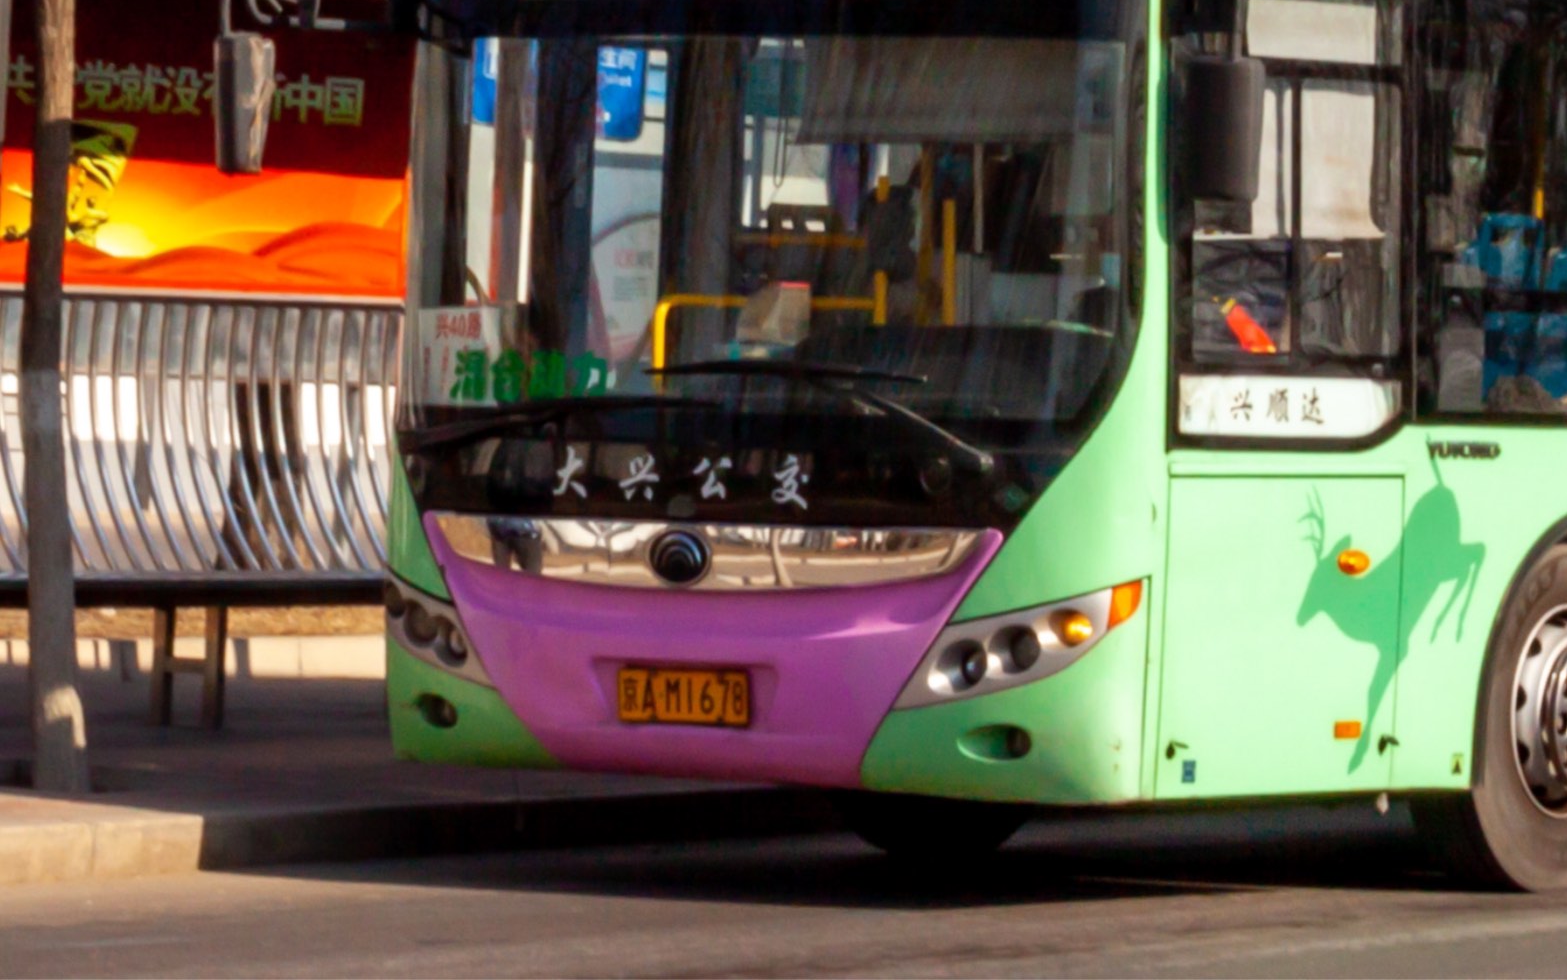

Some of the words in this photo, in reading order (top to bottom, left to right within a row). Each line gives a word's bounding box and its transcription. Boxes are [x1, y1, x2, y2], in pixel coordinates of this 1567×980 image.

[449, 348, 608, 404] 混合动力
[1230, 387, 1325, 425] 兴顺达
[553, 446, 808, 510] 大兴公交
